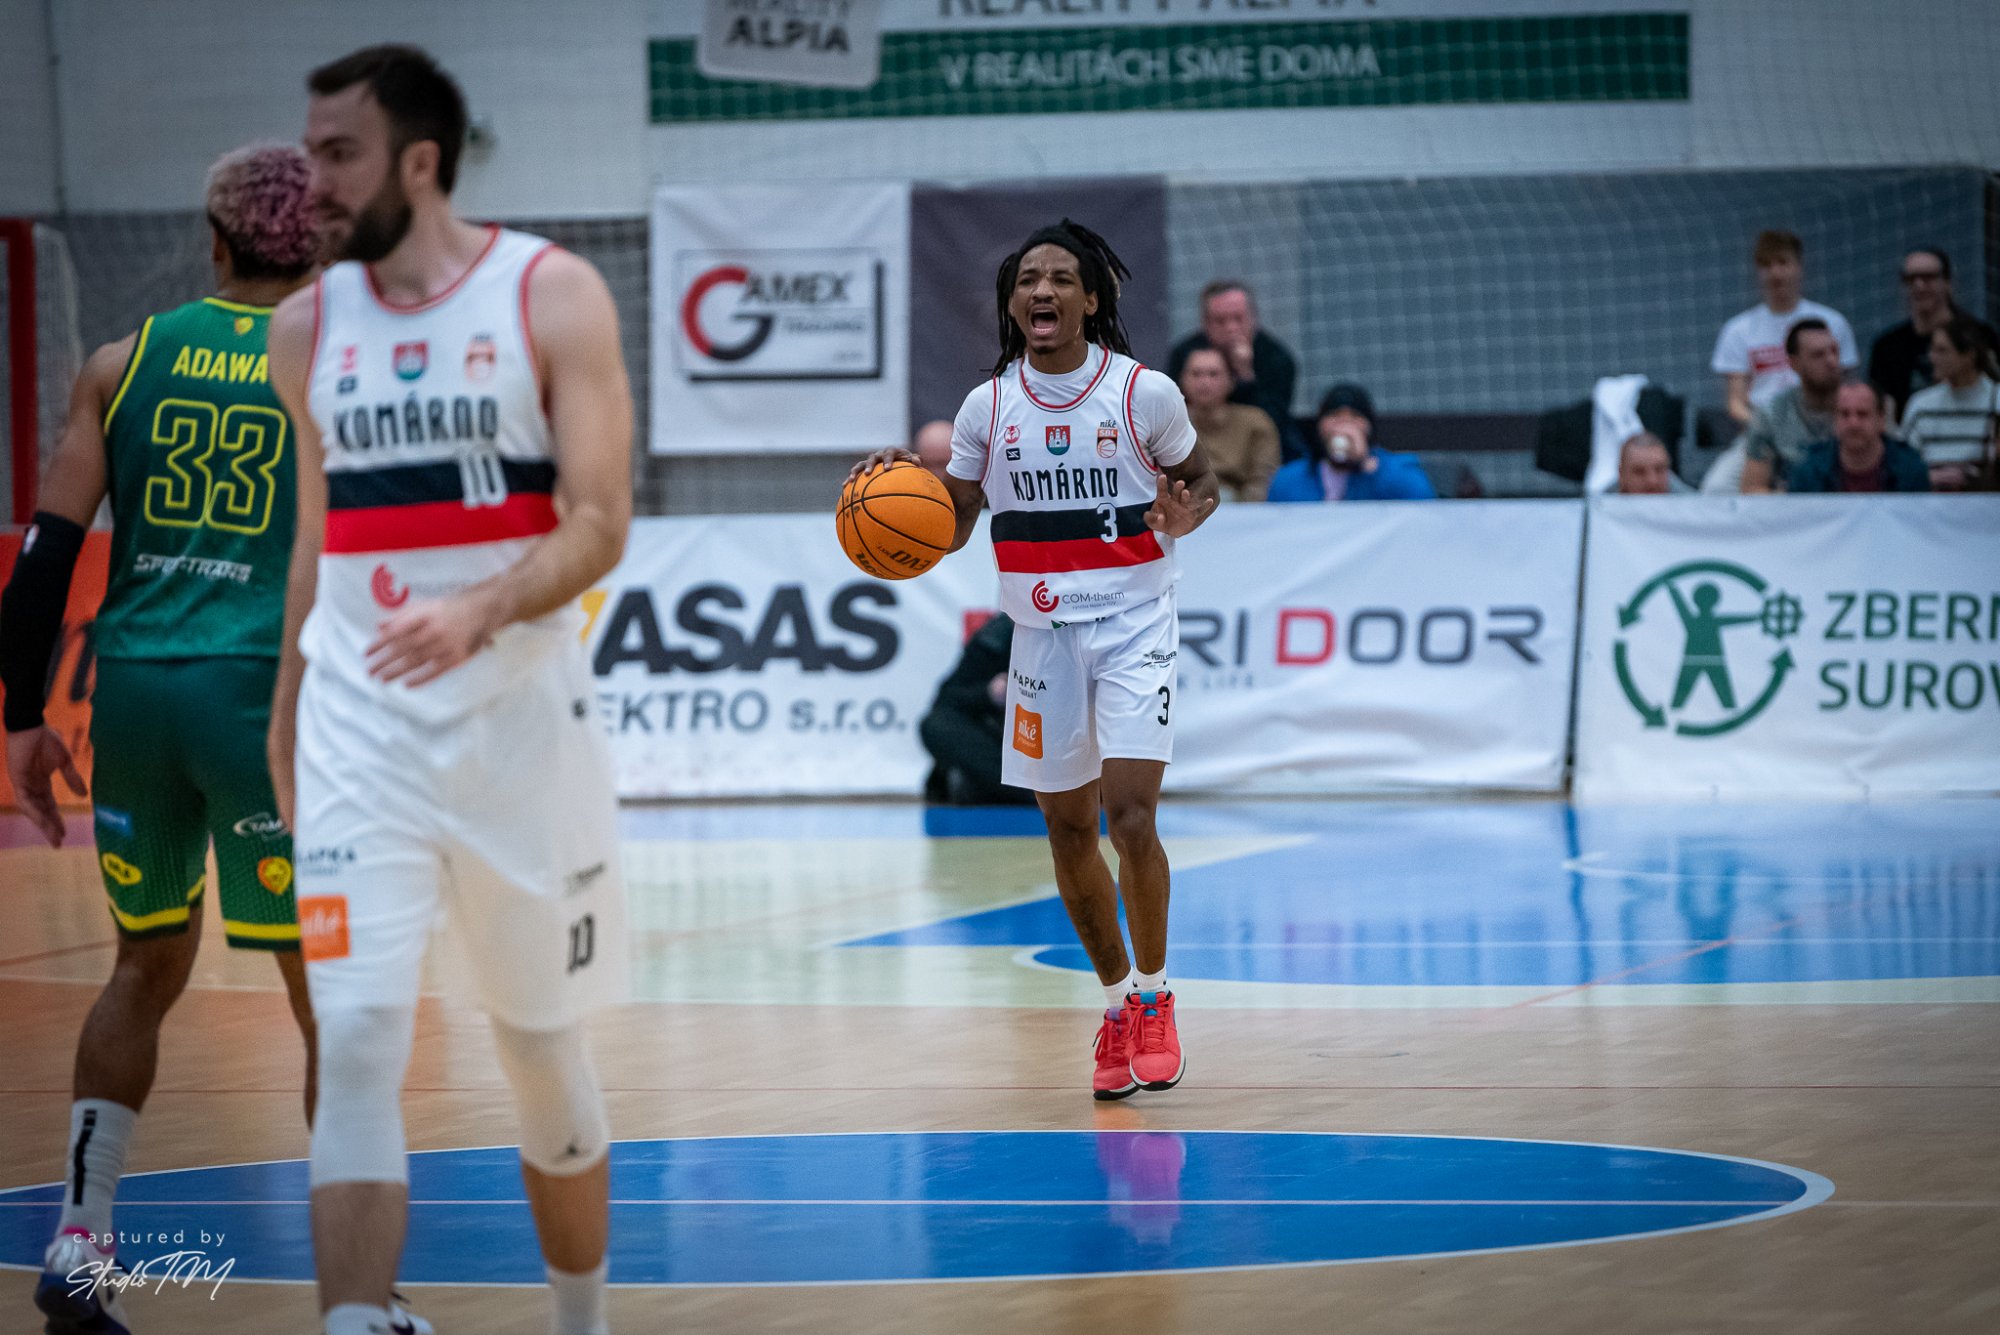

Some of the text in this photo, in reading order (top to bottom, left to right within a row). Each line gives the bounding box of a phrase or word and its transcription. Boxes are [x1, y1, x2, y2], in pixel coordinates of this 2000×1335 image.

[726, 16, 850, 52] ALPIA
[1259, 43, 1381, 81] DOMA
[171, 345, 268, 384] ADAWA
[333, 389, 498, 450] KOMÁRNO
[144, 397, 288, 536] 33
[458, 446, 509, 509] 10
[1009, 462, 1119, 501] KOMÁRNO
[1096, 502, 1119, 543] 3
[1061, 590, 1125, 605] COM-therm
[1824, 590, 2000, 640] ZBER
[593, 580, 901, 676] ASAS
[596, 688, 906, 733] EKTRO s.r.o.
[1157, 685, 1171, 726] 3
